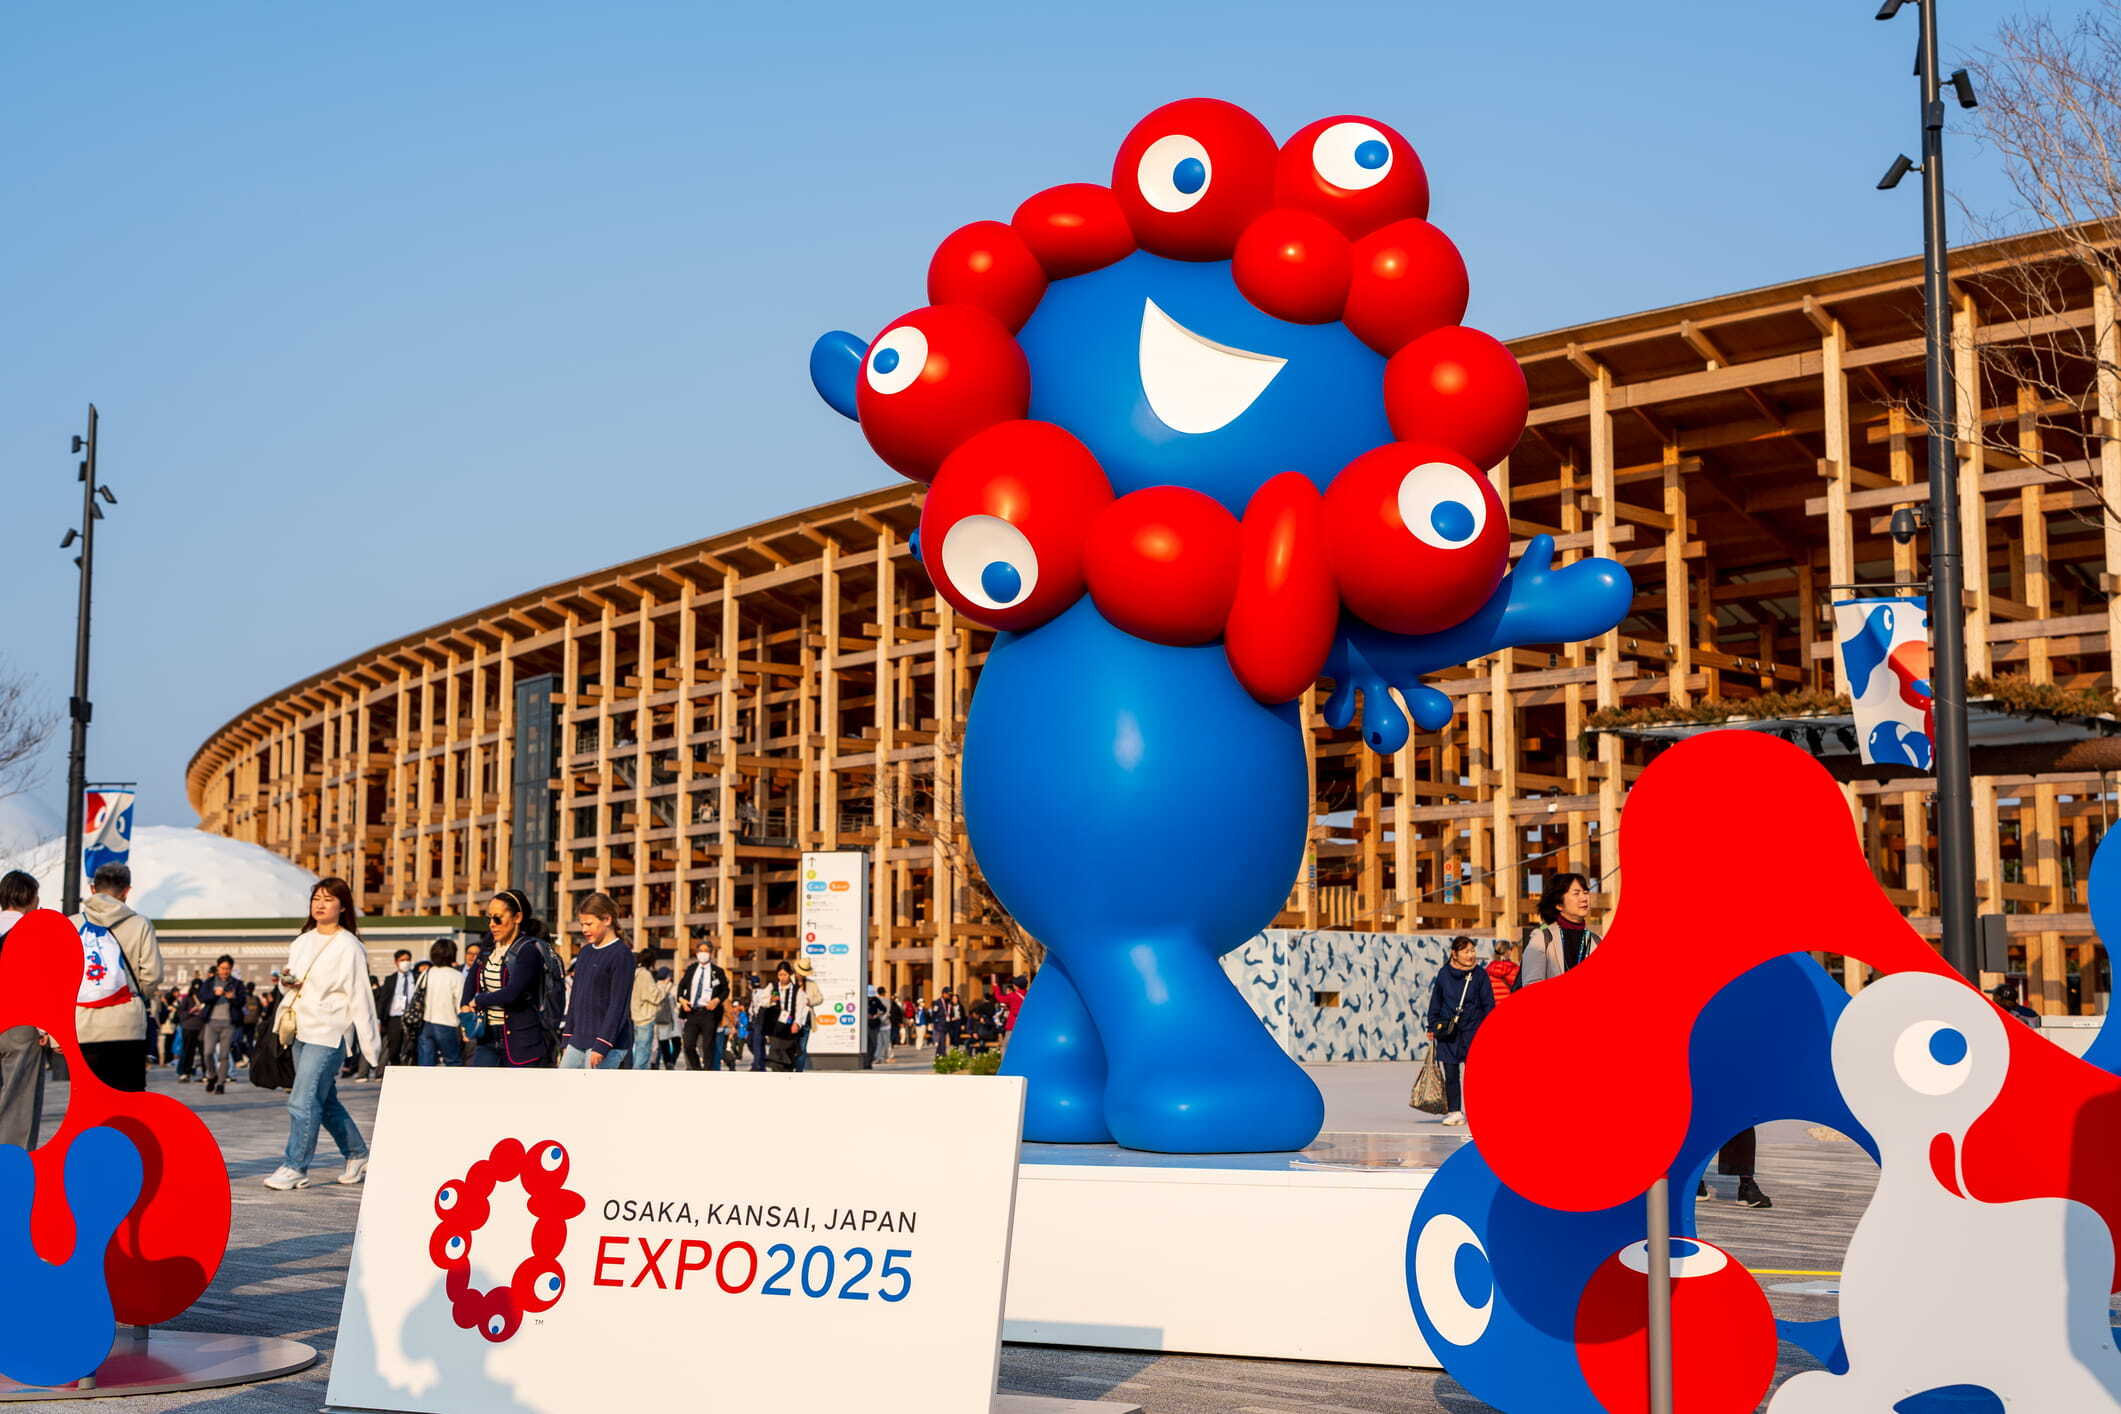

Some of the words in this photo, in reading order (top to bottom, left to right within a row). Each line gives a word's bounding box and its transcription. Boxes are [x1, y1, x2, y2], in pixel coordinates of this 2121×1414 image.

[603, 1199, 699, 1228] OSAKA,
[707, 1203, 816, 1233] KANSAI,
[823, 1208, 917, 1234] JAPAN
